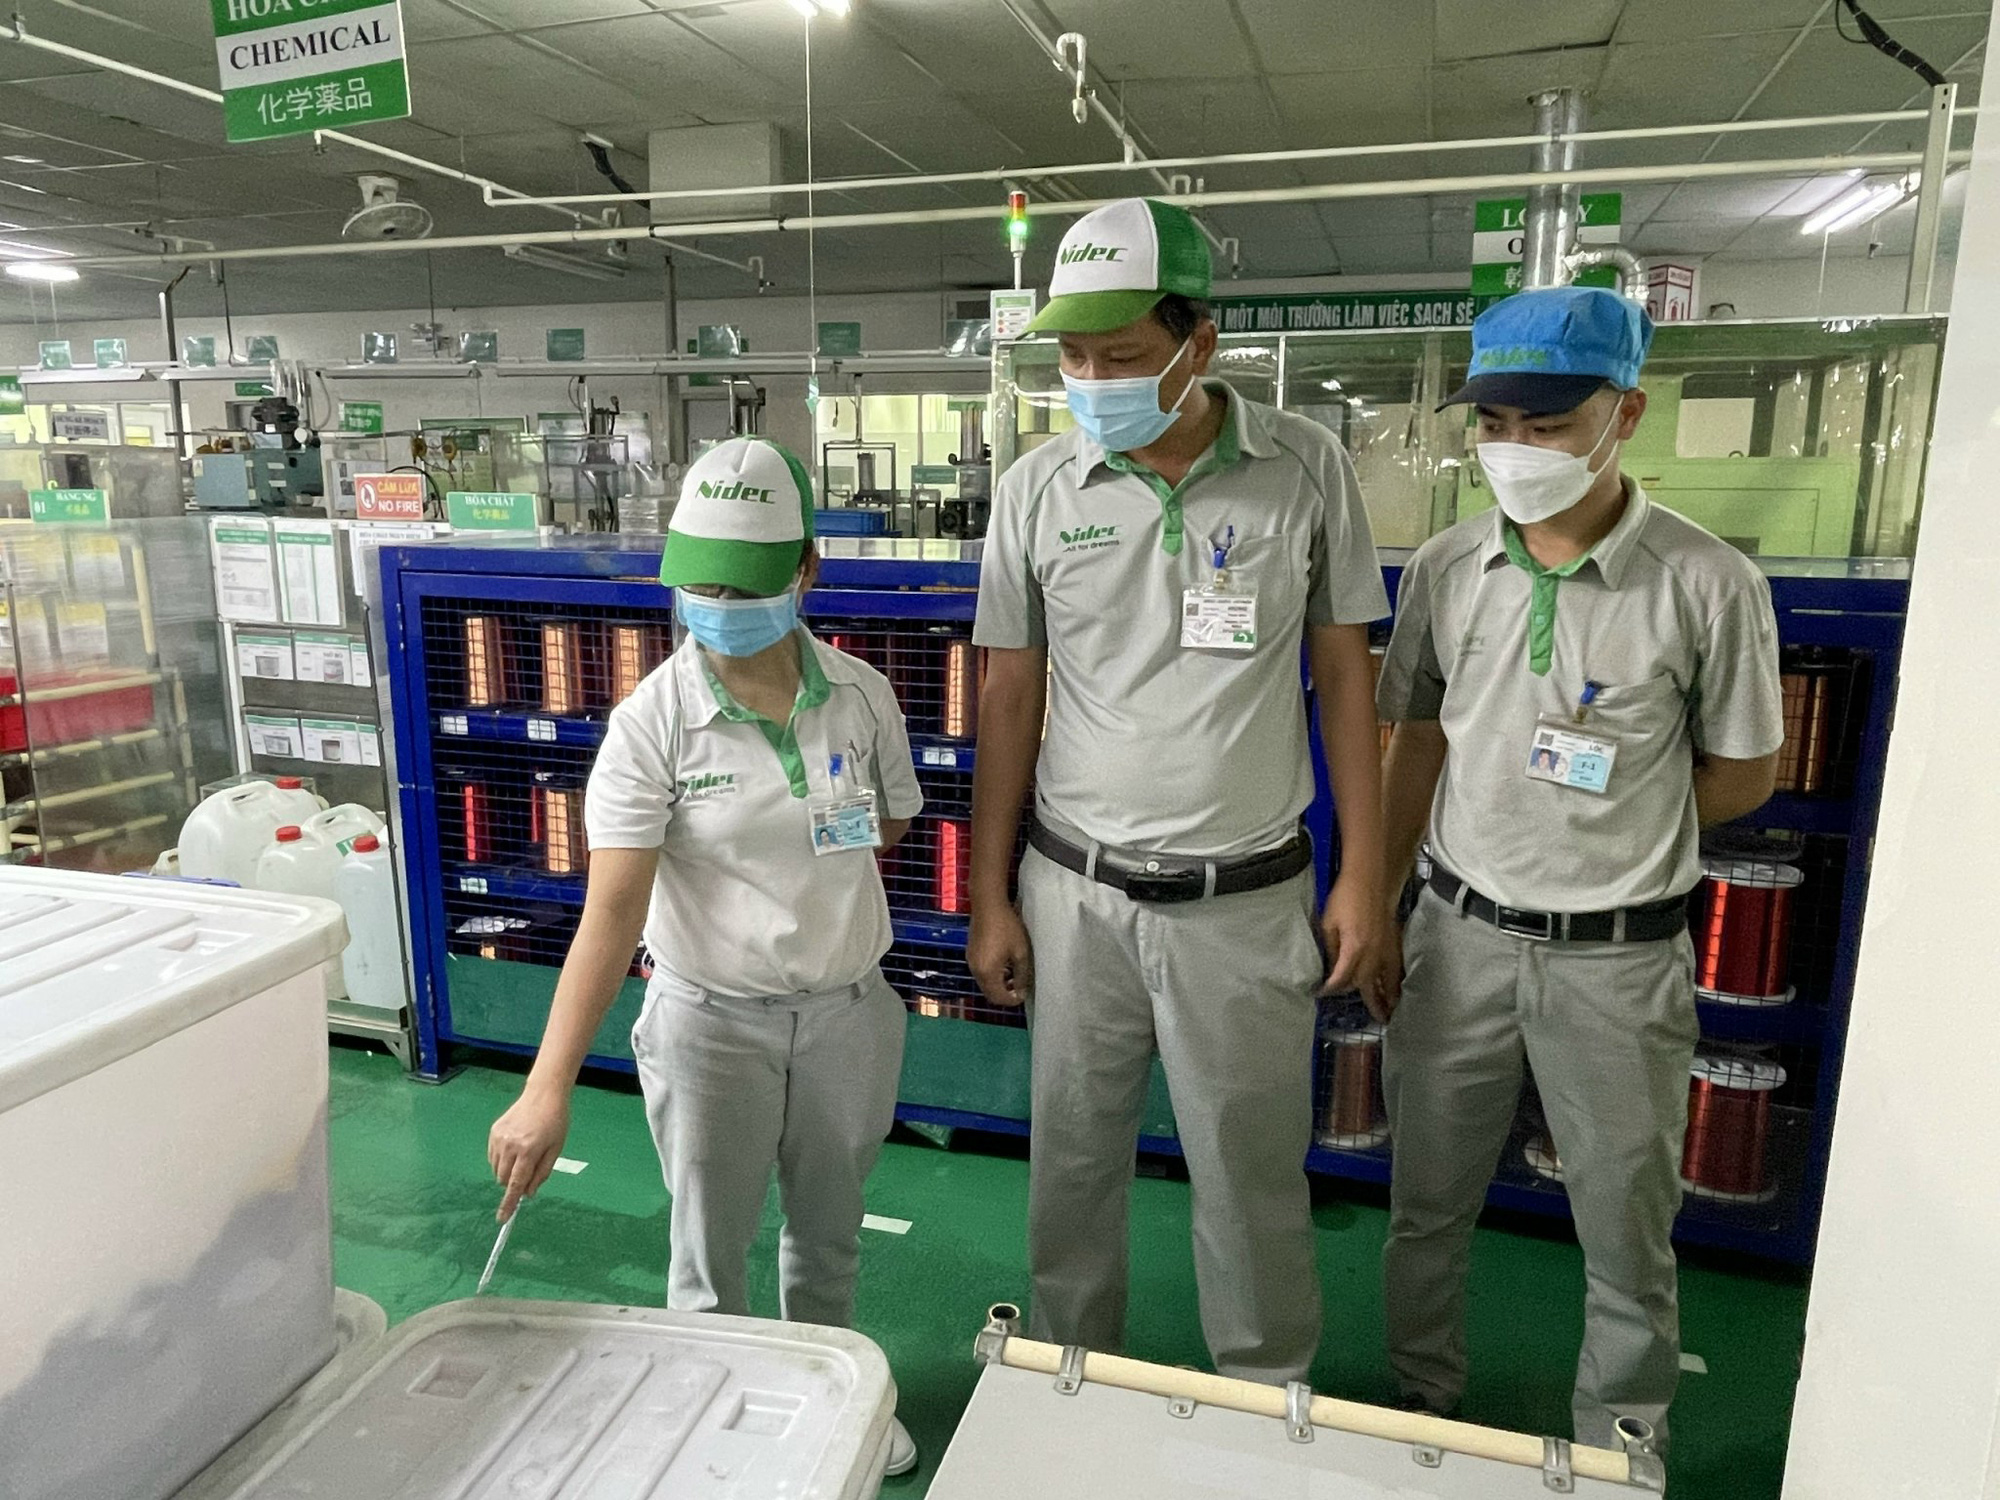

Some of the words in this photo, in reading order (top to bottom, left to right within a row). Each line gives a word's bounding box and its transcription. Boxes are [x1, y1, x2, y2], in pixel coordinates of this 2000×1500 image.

[230, 19, 391, 70] CHEMICAL
[257, 77, 373, 125] 化学薬品
[1060, 243, 1129, 265] Nidec
[695, 480, 777, 504] Nidec
[378, 500, 394, 512] NO
[395, 500, 419, 513] FIRE
[1057, 525, 1123, 545] Nidec
[1090, 540, 1120, 549] dreams
